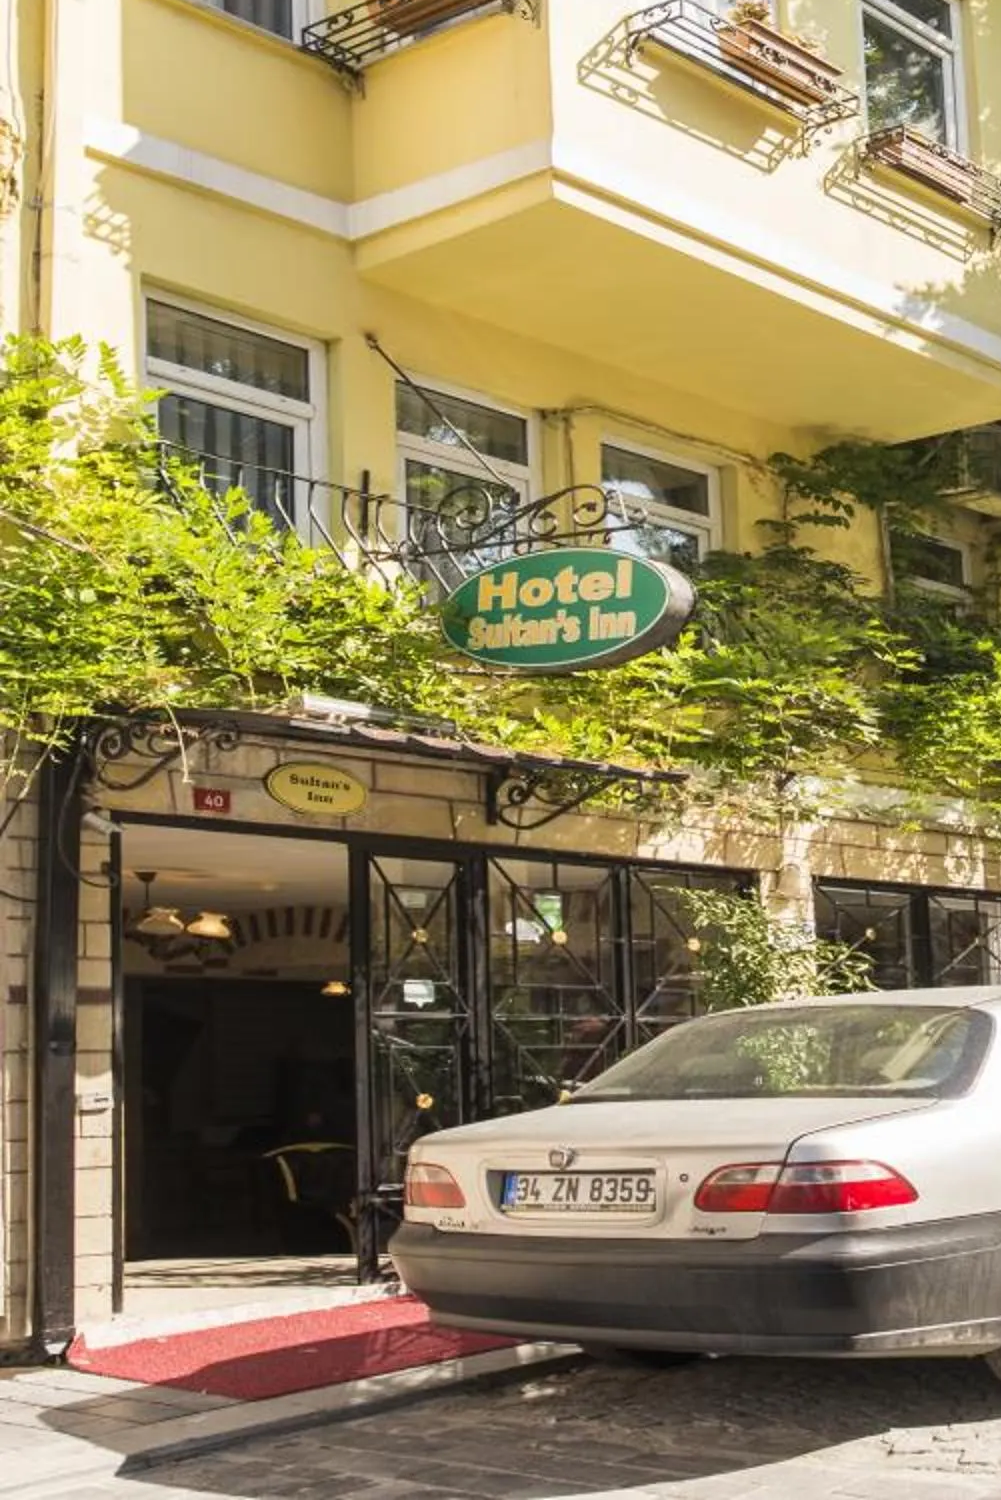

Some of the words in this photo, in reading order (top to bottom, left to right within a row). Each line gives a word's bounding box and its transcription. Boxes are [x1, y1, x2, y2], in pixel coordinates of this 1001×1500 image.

[477, 559, 633, 612] Hotel
[467, 608, 581, 649] Sultan's
[588, 606, 636, 640] Inn
[289, 772, 351, 791] Sultan's
[203, 794, 224, 808] 40
[307, 791, 333, 805] Inn
[517, 1177, 541, 1201] 34
[551, 1177, 580, 1203] ZN
[589, 1177, 651, 1203] 8359
